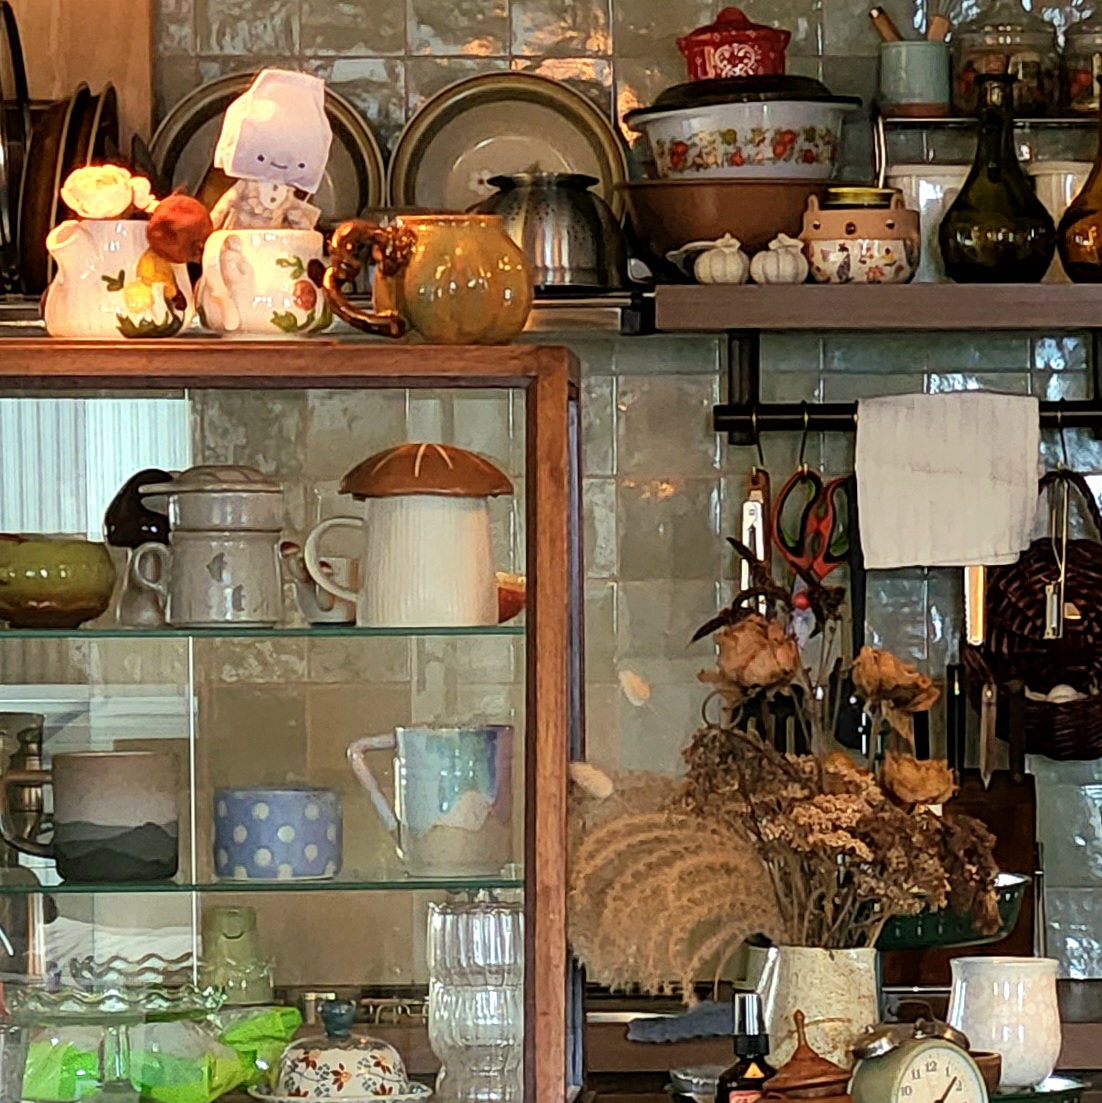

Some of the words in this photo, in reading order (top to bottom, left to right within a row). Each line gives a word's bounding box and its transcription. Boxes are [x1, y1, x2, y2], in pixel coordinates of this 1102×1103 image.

[925, 1061, 938, 1072] 12
[945, 1066, 951, 1077] 1
[911, 1069, 922, 1080] 11
[955, 1080, 963, 1091] 2
[901, 1086, 913, 1097] 10
